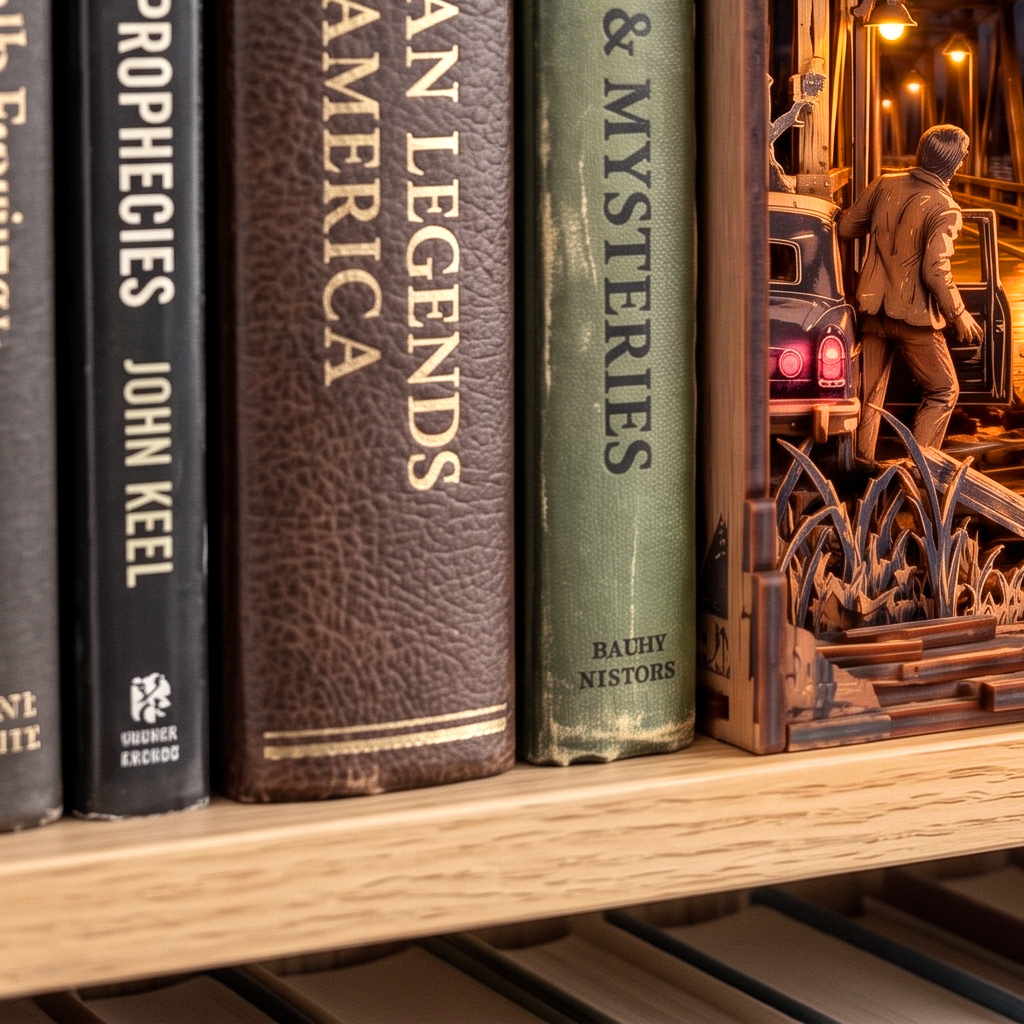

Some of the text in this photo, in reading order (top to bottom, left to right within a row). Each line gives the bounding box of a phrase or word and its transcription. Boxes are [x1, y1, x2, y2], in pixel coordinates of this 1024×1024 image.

[603, 8, 651, 57] &
[405, 131, 462, 491] LEGENDS
[603, 79, 652, 476] MYSTERIES
[123, 358, 174, 589] JOHN KEEL
[579, 661, 675, 690] NISTORS
[592, 633, 667, 659] BAUHY
